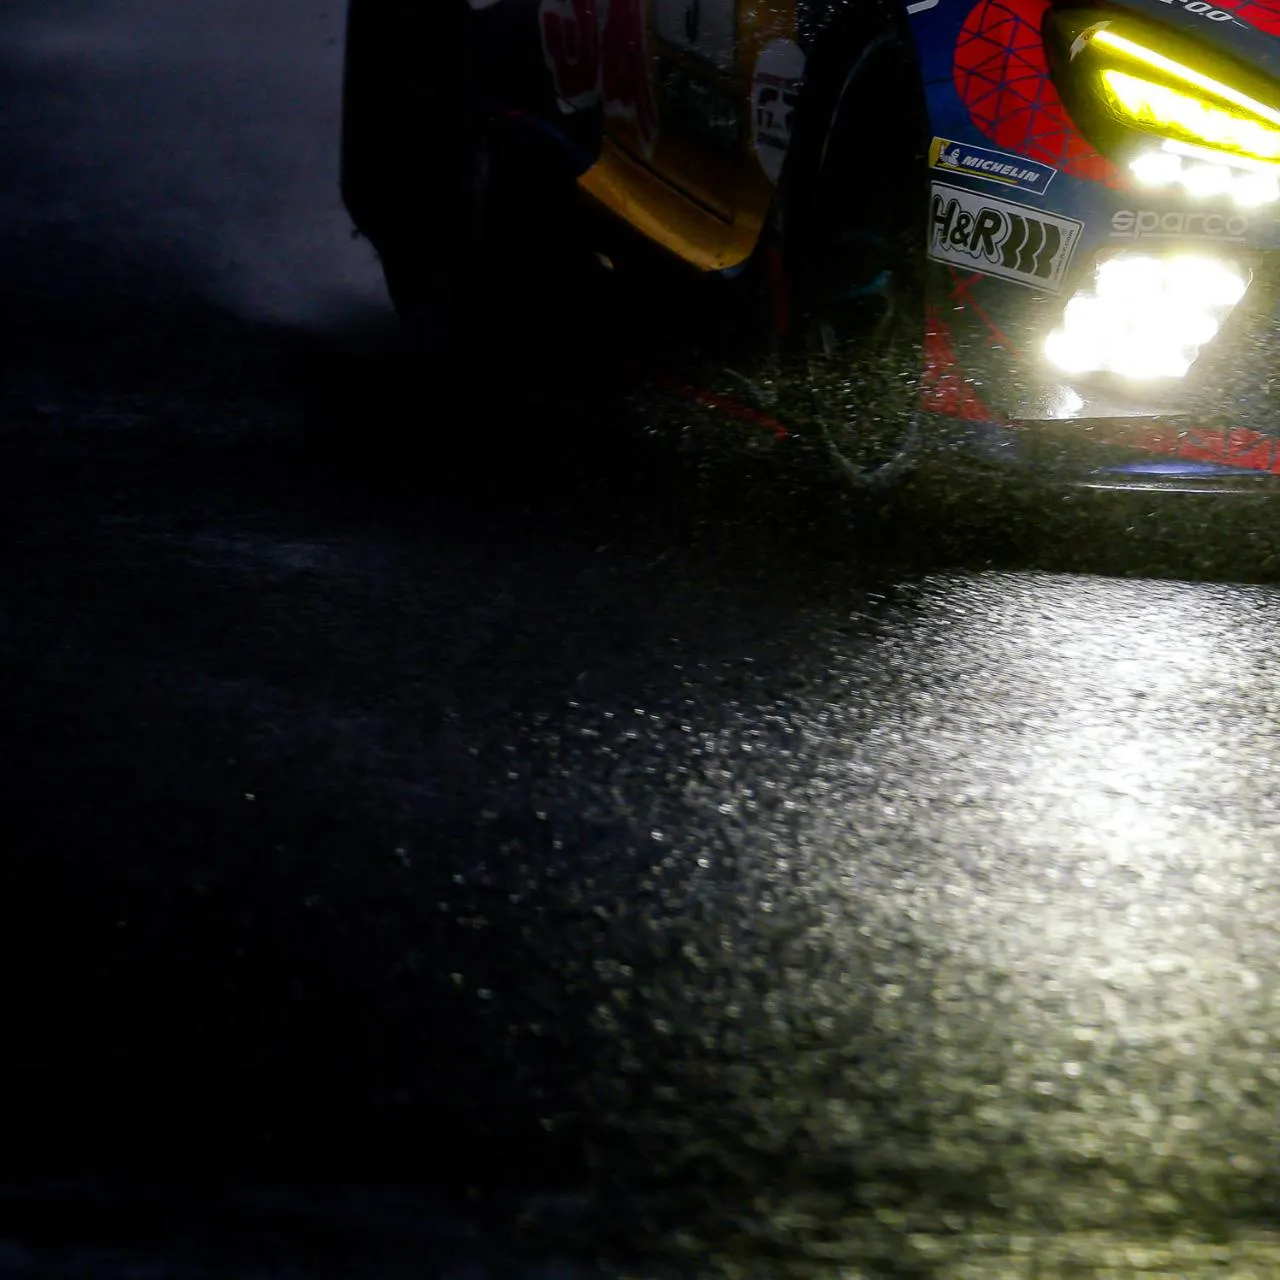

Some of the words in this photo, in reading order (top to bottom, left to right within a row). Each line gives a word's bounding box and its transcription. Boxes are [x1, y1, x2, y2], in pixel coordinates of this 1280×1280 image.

[961, 154, 1040, 183] MICHELIN
[931, 195, 1005, 260] H&R
[1111, 209, 1250, 239] sparco
